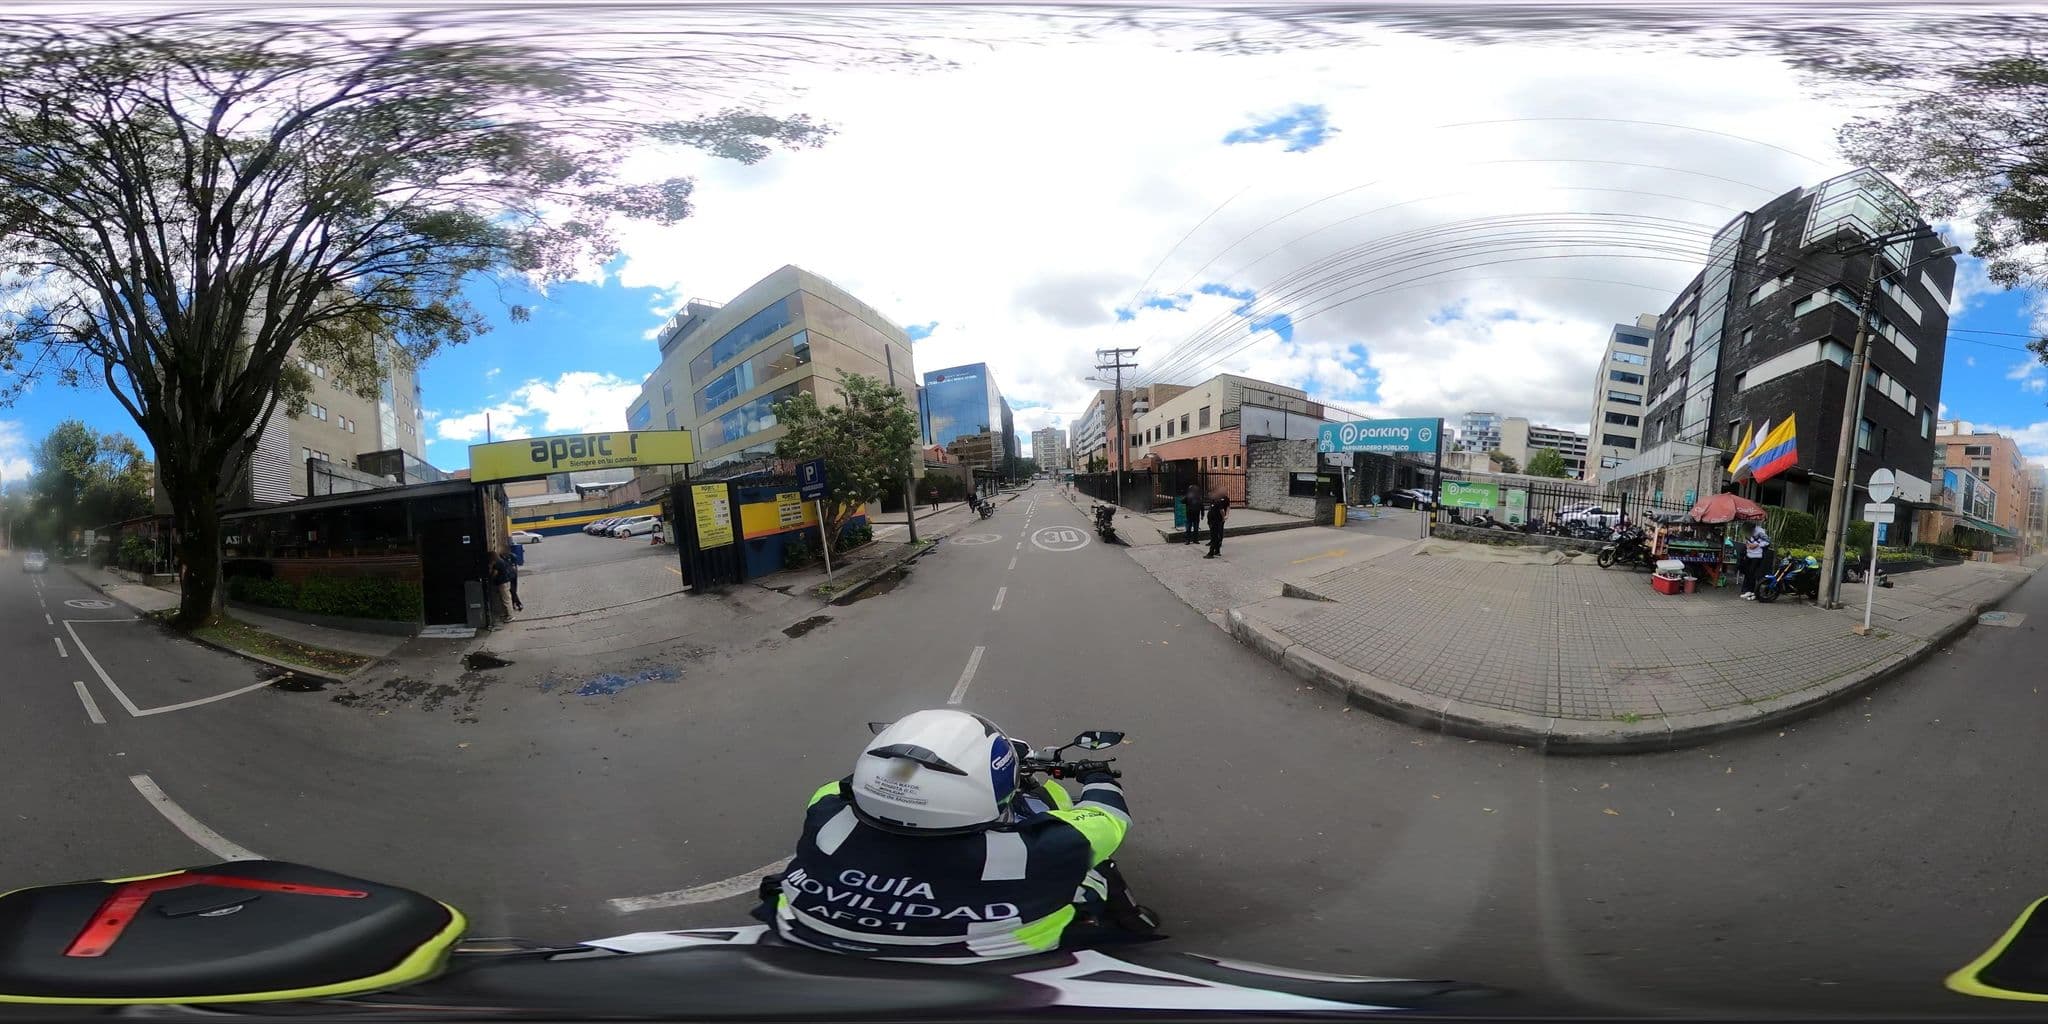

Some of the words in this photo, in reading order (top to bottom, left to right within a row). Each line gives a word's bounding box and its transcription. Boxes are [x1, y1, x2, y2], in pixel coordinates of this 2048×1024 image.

[1360, 427, 1409, 441] parking
[569, 459, 597, 467] Siempre
[805, 465, 815, 481] P
[1044, 531, 1080, 542] 30
[839, 869, 935, 900] GUÍA
[787, 868, 1020, 920] MOVILIDAD
[807, 905, 908, 931] AF01
